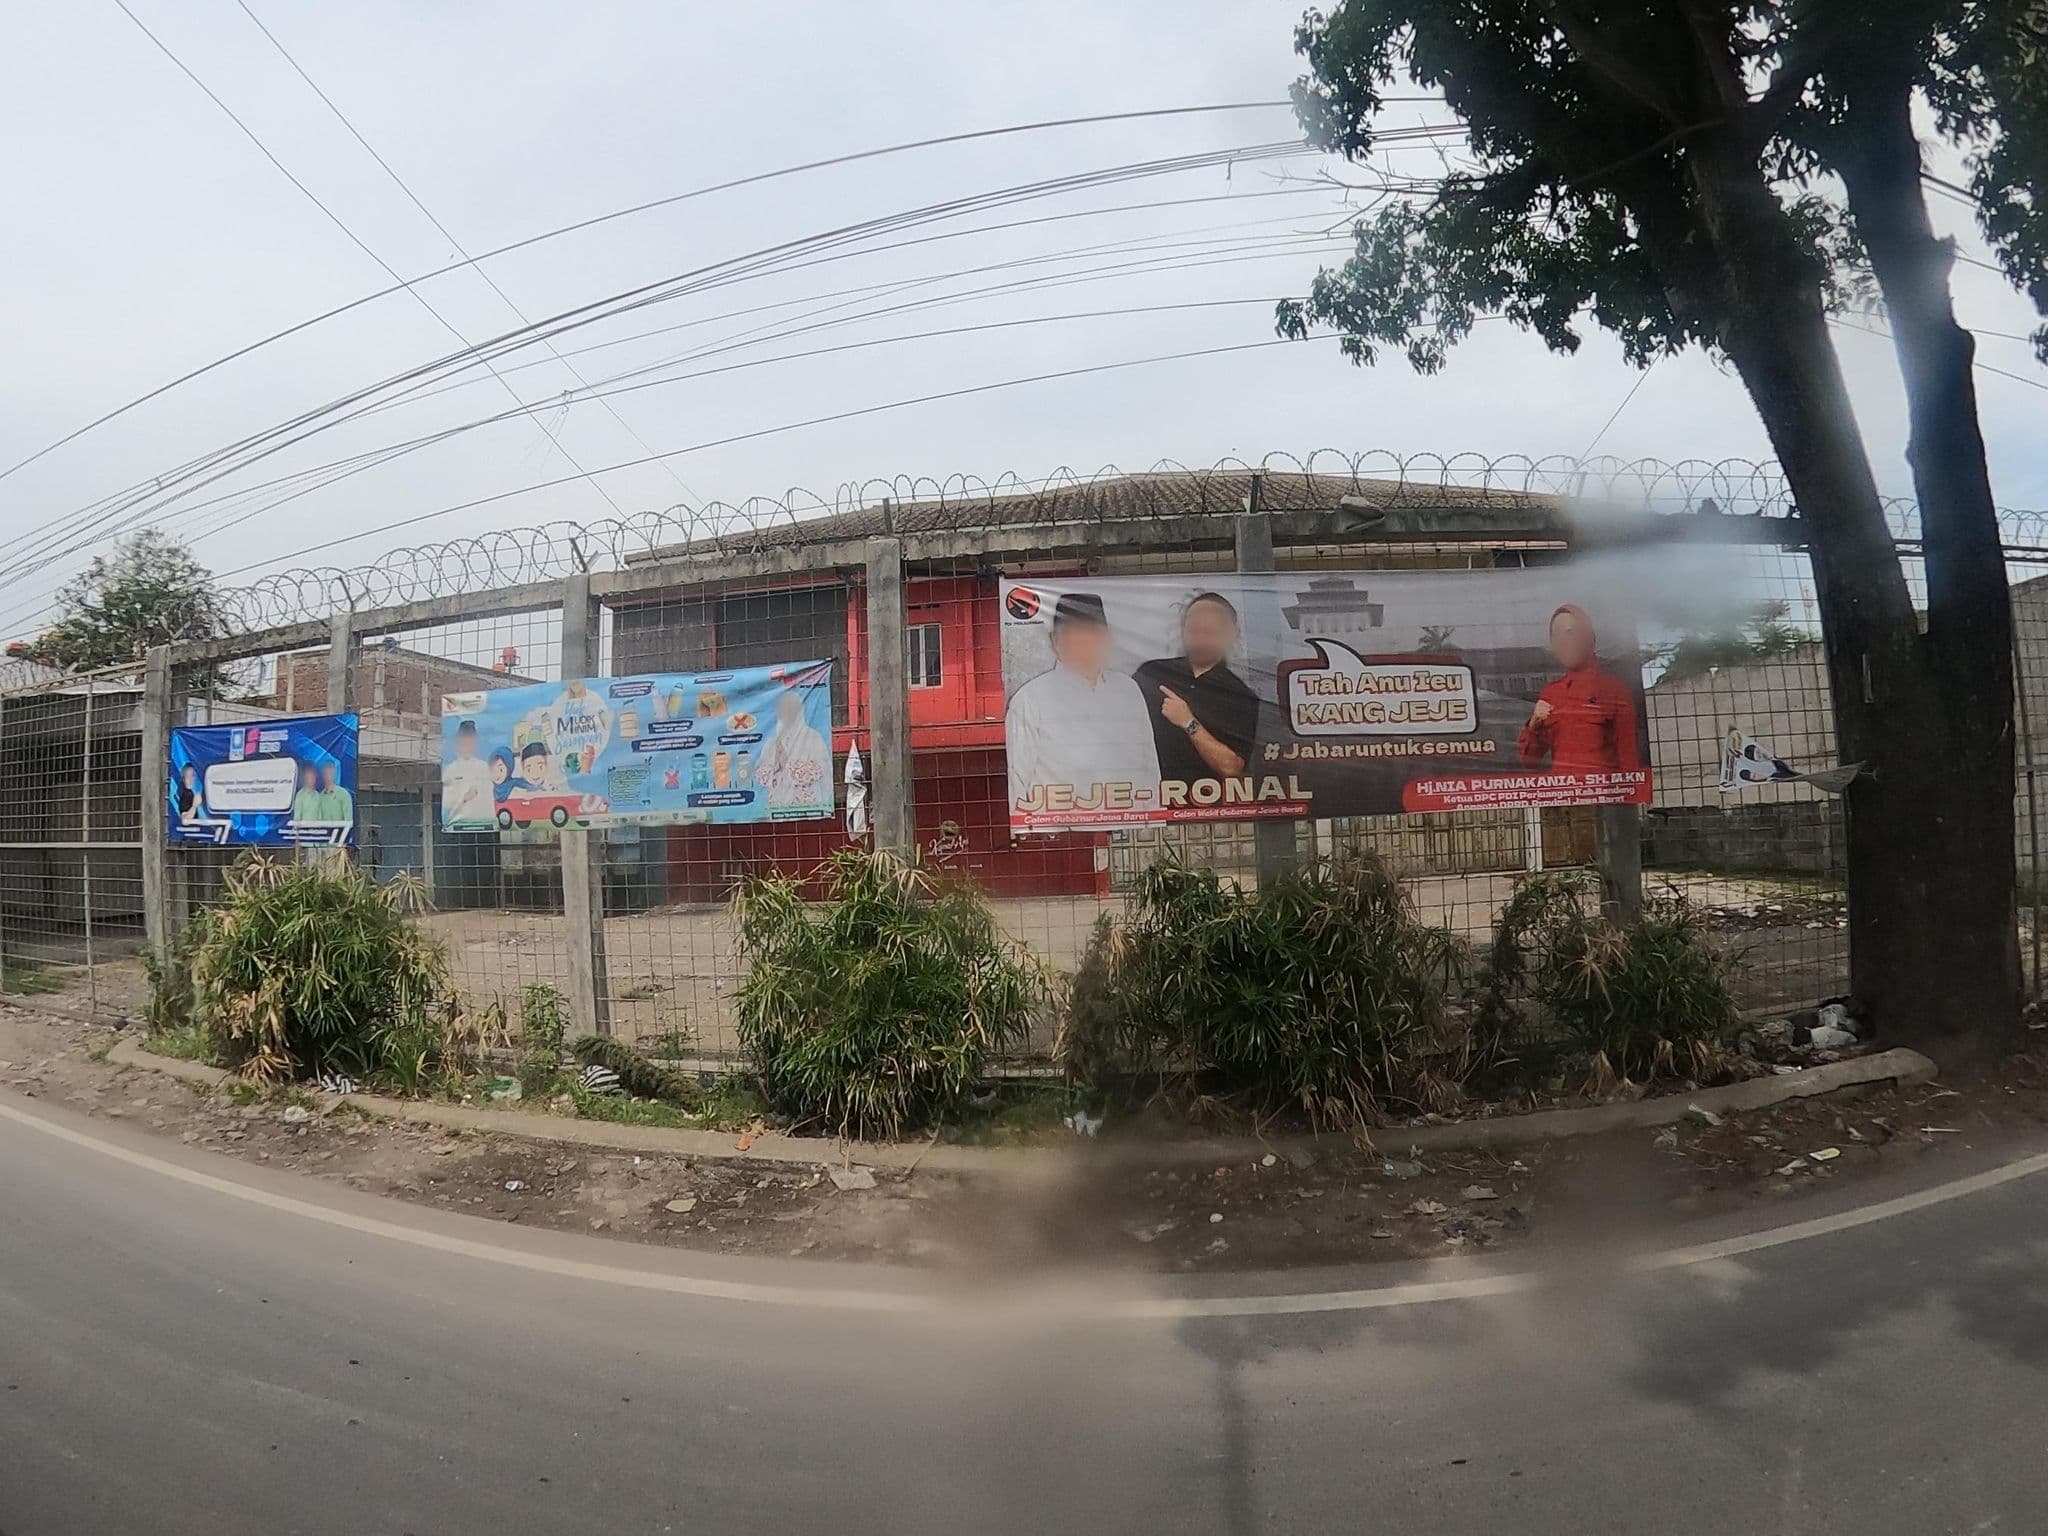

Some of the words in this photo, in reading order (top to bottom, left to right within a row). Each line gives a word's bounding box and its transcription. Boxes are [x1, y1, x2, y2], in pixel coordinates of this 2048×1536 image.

[1298, 673, 1352, 695] Tah
[1357, 672, 1412, 694] Anu
[1413, 671, 1463, 691] Ieu
[1299, 702, 1386, 725] KANG
[1389, 699, 1468, 722] JEJE
[1474, 793, 1497, 802] DPC
[1498, 792, 1519, 801] PDI
[1024, 815, 1051, 825] Calon
[1052, 814, 1096, 823] Gubernur
[1096, 813, 1122, 822] Jawa
[1123, 812, 1149, 821] Barat
